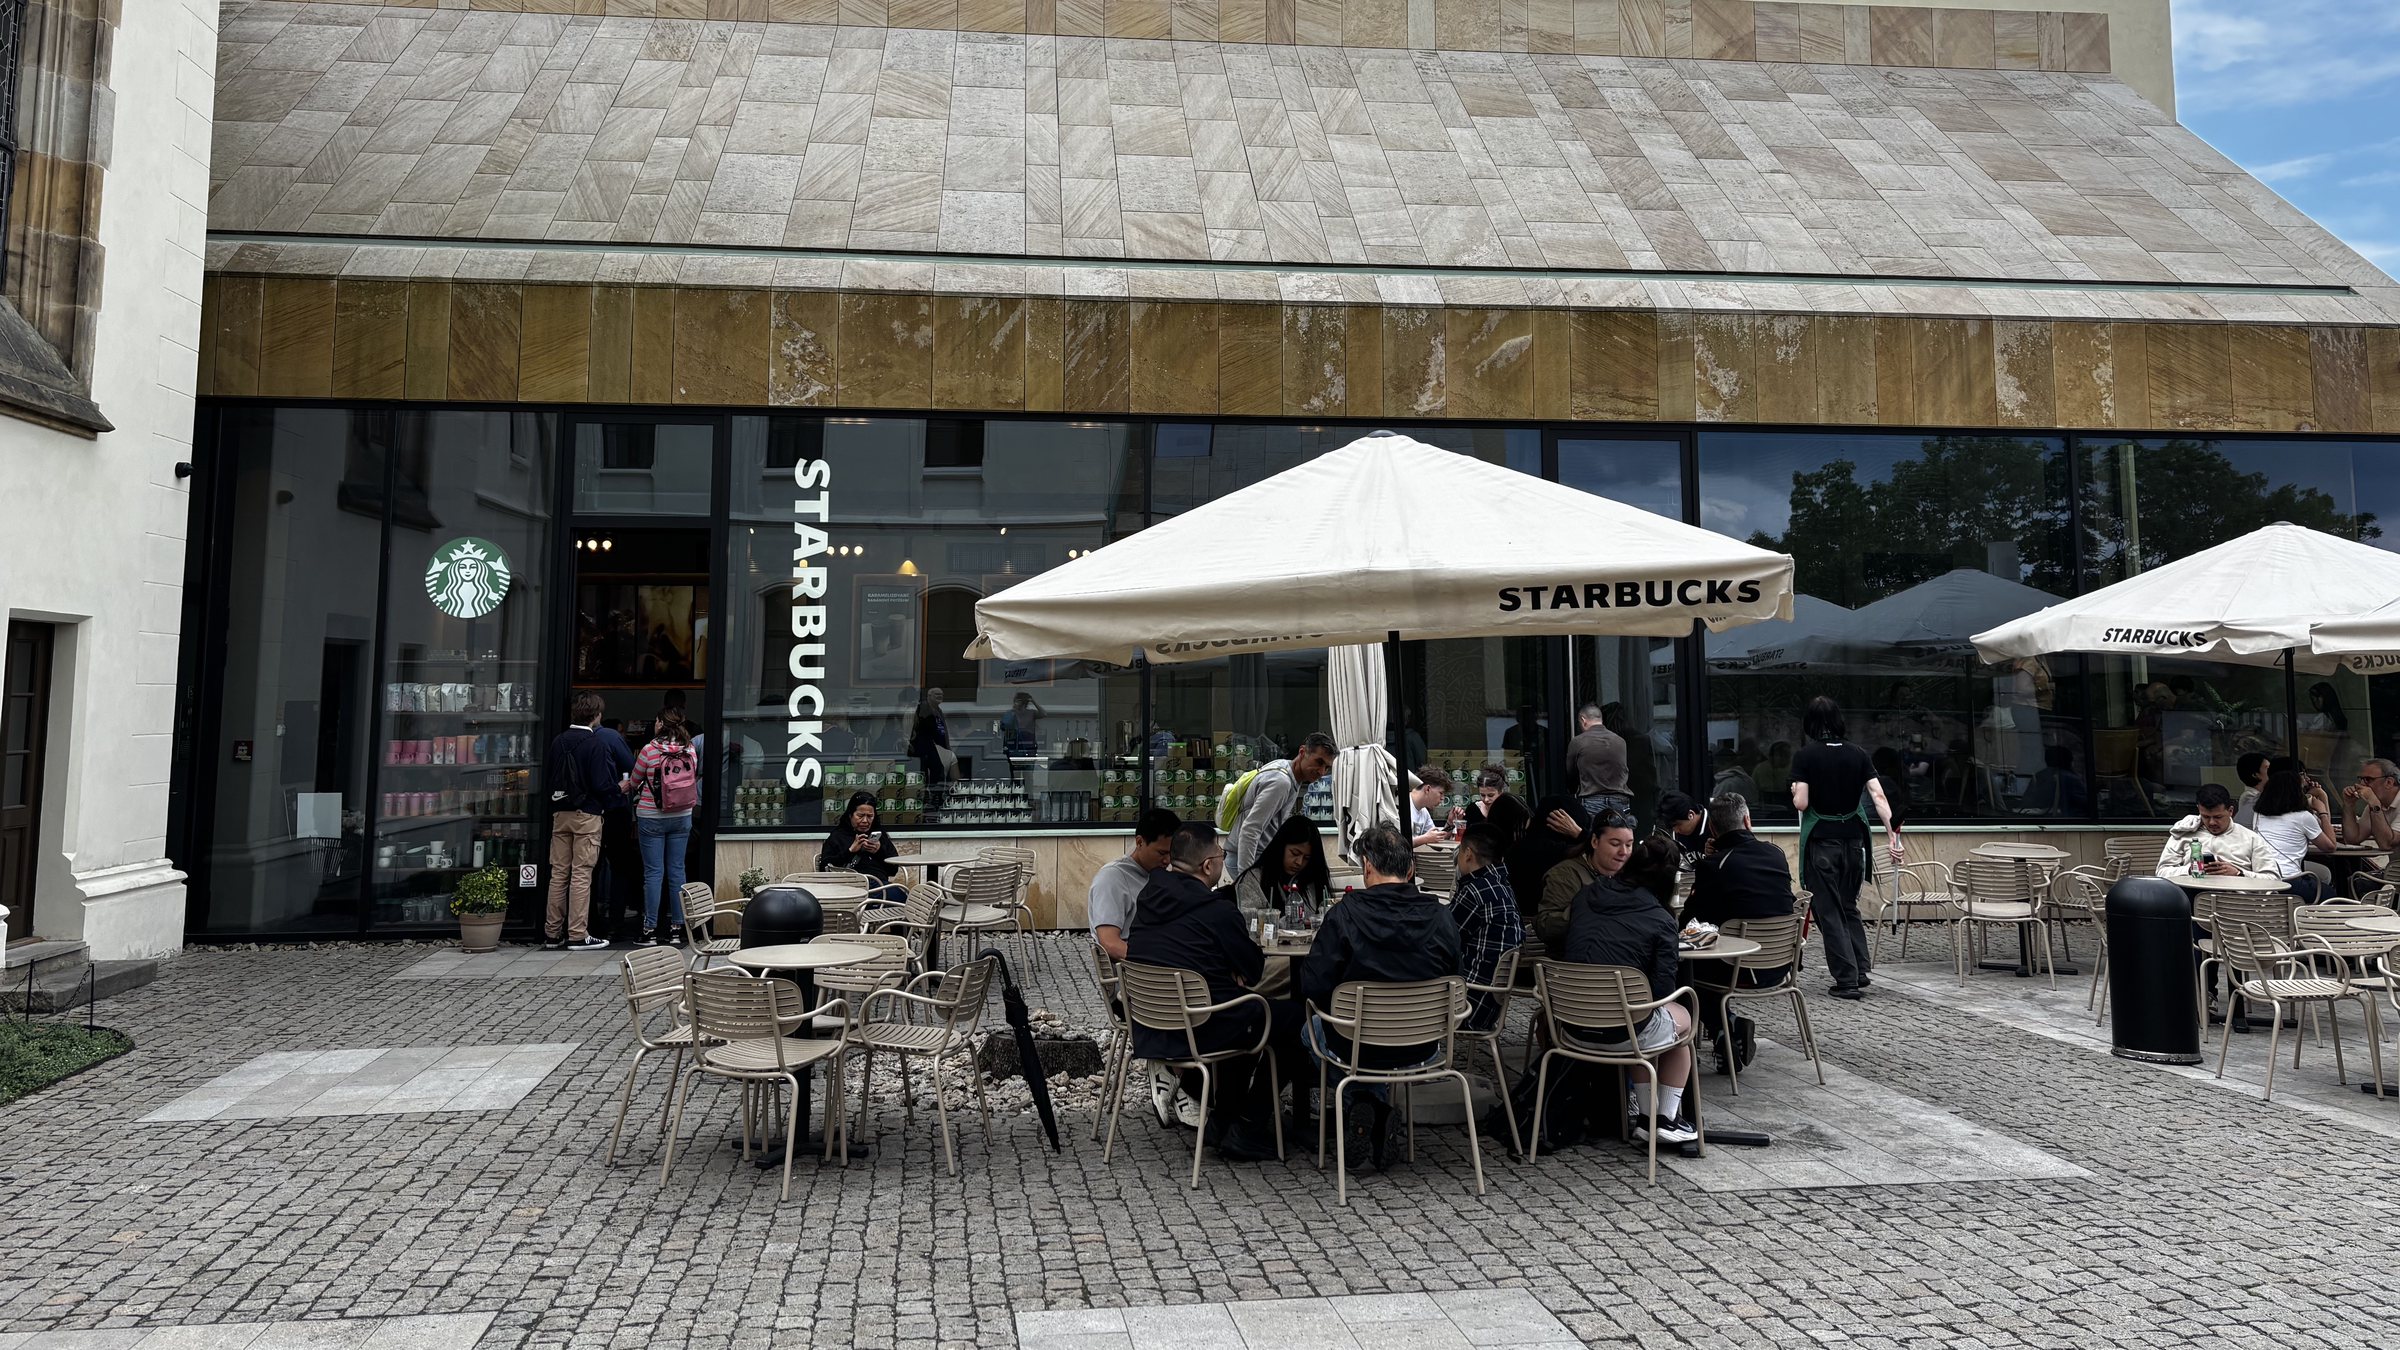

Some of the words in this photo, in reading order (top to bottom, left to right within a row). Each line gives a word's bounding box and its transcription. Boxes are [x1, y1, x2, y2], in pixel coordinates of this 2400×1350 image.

[1498, 579, 1761, 612] STARBUCKS
[785, 457, 831, 790] STARBUCKS
[2102, 627, 2208, 648] STARBUCKS
